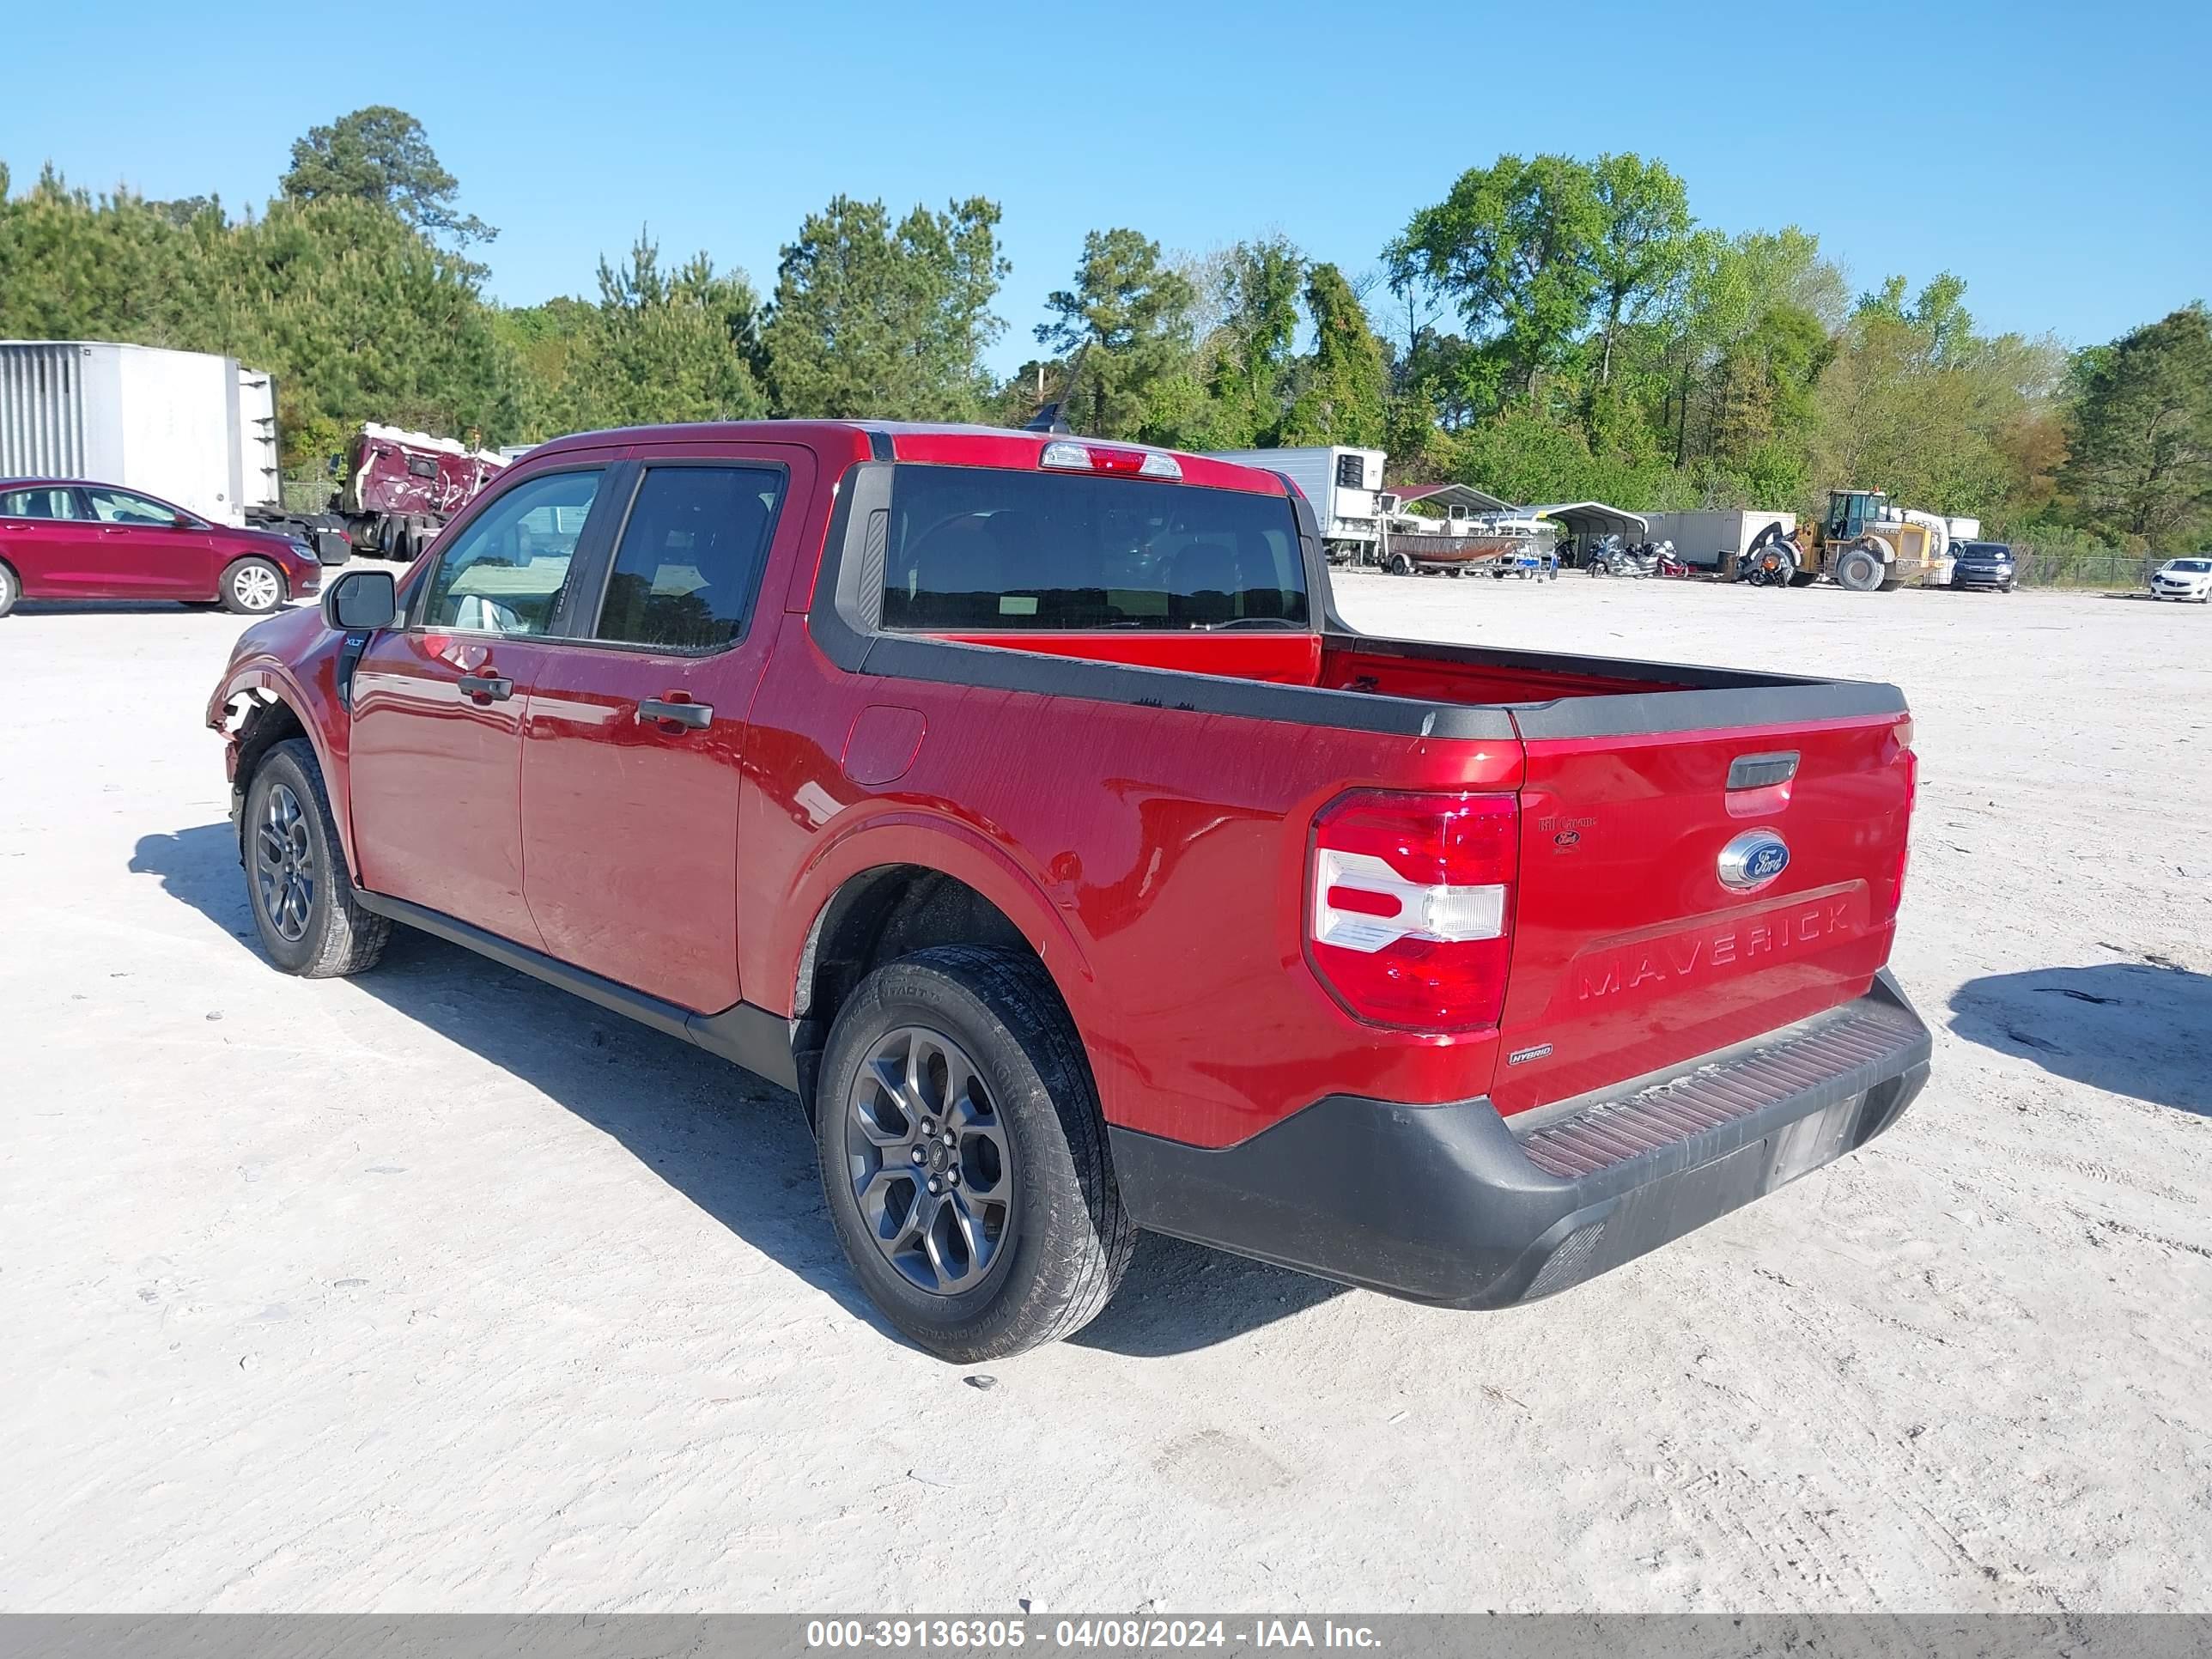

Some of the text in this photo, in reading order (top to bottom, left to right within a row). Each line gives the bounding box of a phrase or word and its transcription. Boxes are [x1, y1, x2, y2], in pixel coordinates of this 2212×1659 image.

[344, 637, 364, 647] XLT
[1754, 849, 1784, 875] Ford
[1578, 902, 1849, 1000] MAVERICK
[1512, 1047, 1552, 1063] HYBRID
